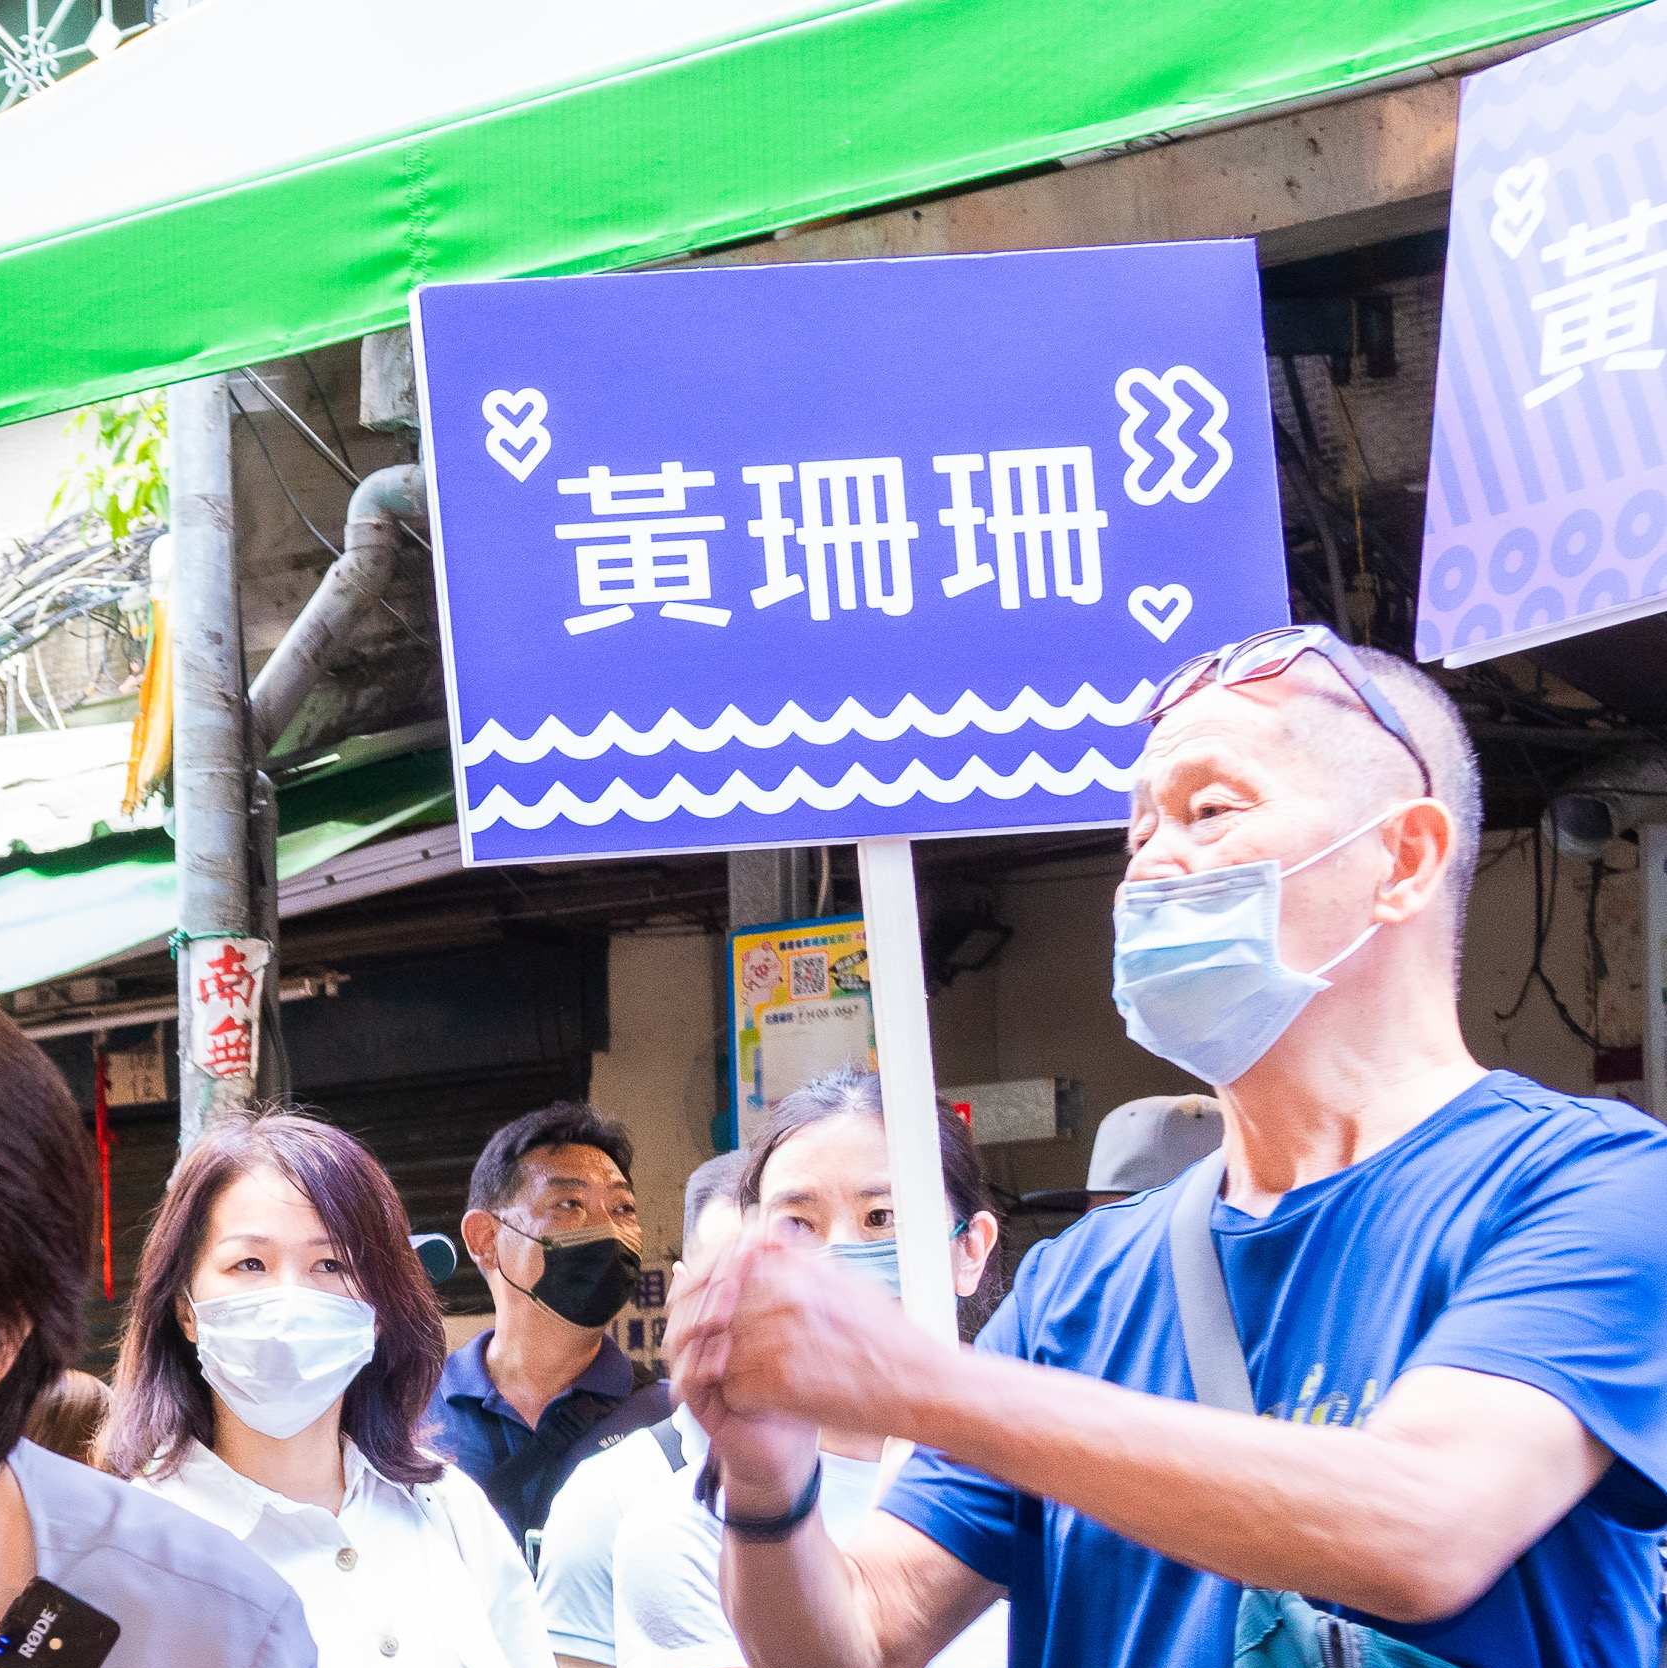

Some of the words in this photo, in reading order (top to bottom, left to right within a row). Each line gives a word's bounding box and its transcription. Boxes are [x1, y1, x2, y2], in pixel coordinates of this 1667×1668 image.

[554, 445, 1109, 637] 黃珊珊
[17, 1607, 59, 1659] RØDE
